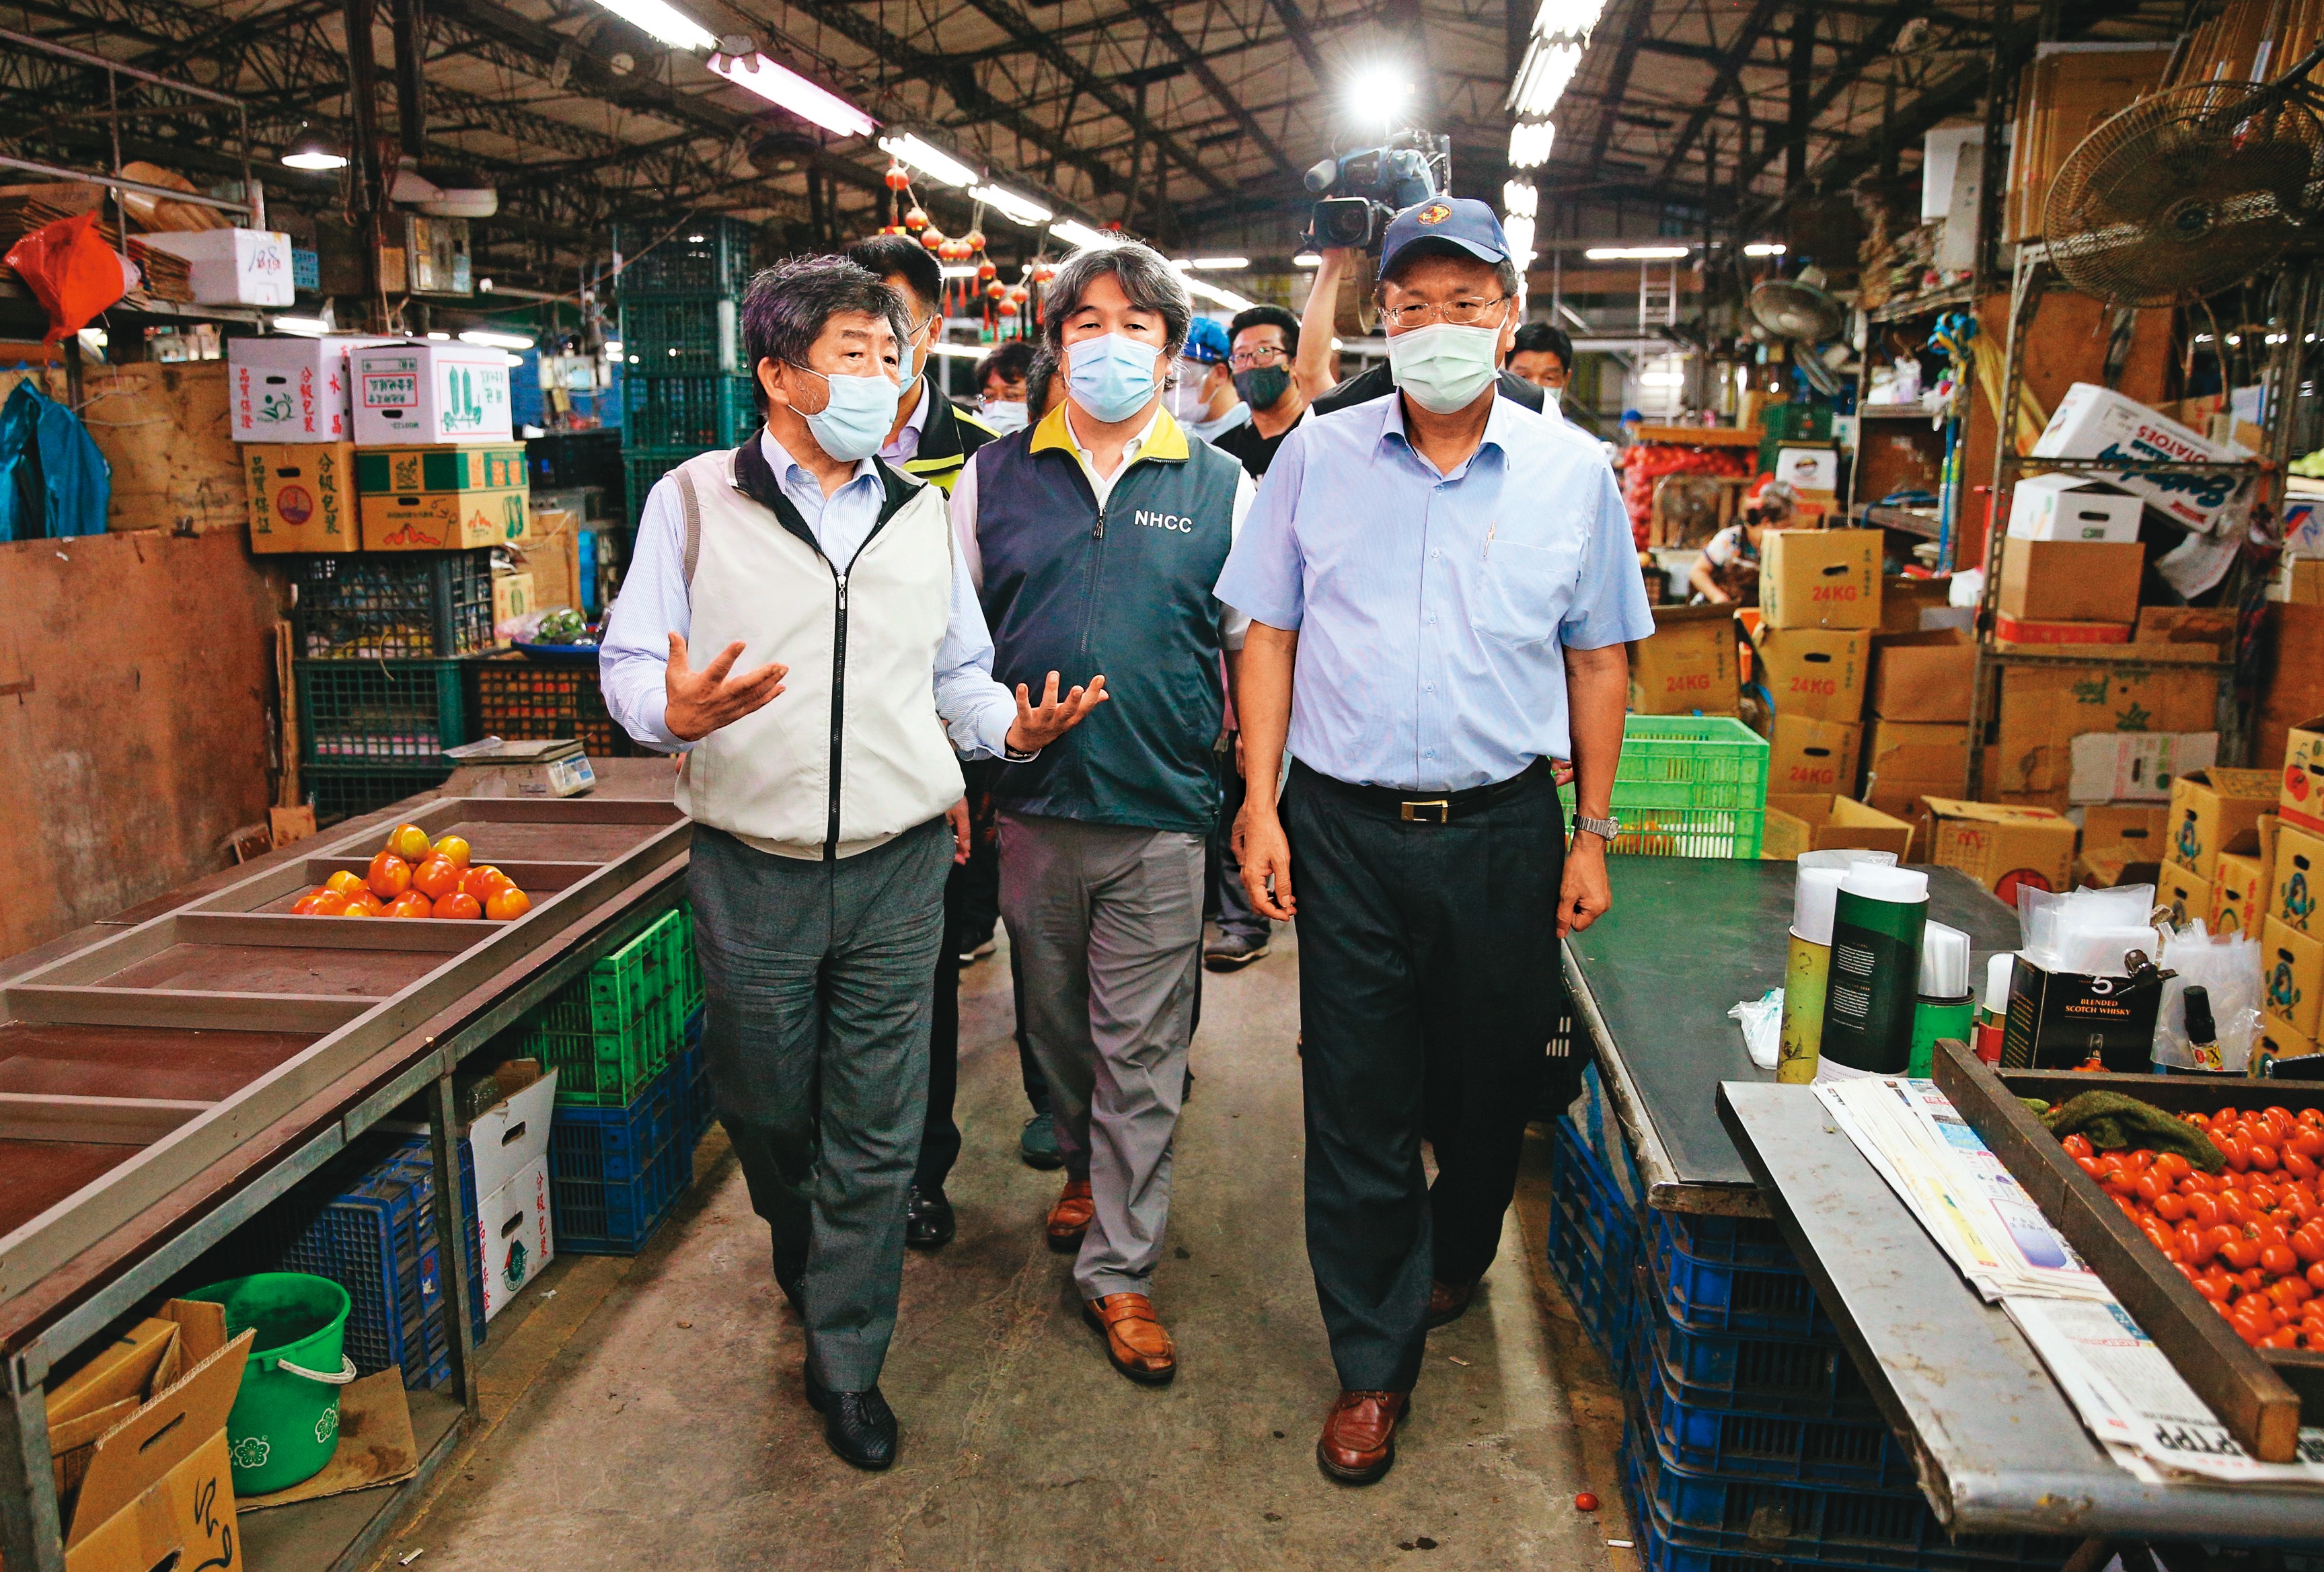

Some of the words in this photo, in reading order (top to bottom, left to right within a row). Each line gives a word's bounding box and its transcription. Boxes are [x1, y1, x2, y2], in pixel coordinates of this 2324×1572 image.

[2136, 424, 2208, 463] OTATOES
[319, 453, 340, 535] 分級包裝
[1134, 510, 1193, 533] NHCC
[1812, 586, 1857, 602] 24KG
[1667, 674, 1711, 692] 24KG
[1789, 677, 1836, 696] 24KG
[1789, 766, 1834, 784] 24KG
[2065, 1005, 2097, 1014] SCOTCH
[2099, 1007, 2131, 1016] WHISKY
[2081, 998, 2118, 1006] BLENDED
[537, 1171, 548, 1259] 分級包裝
